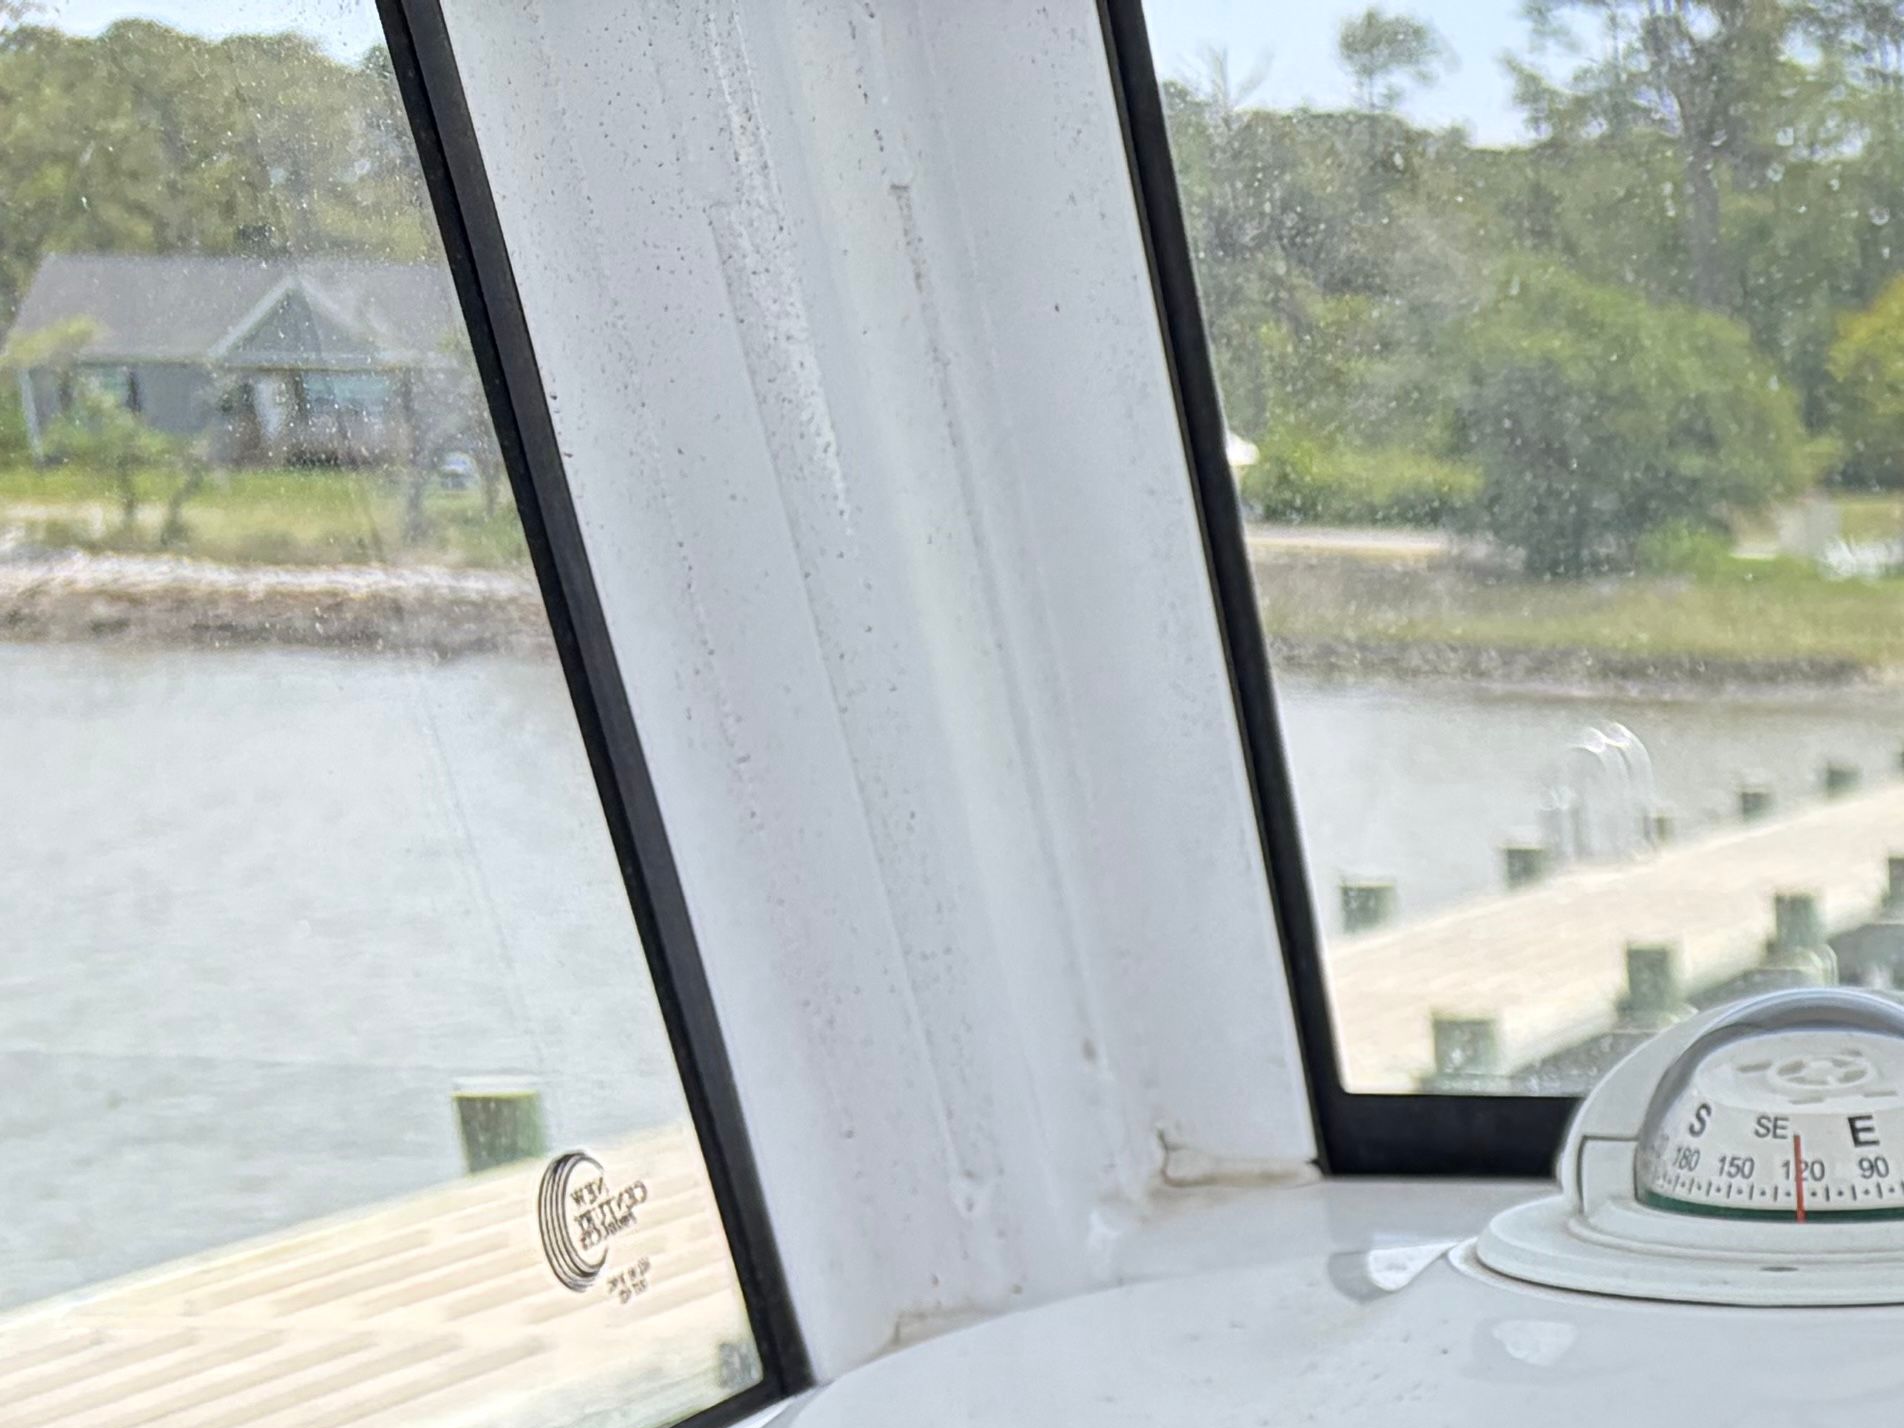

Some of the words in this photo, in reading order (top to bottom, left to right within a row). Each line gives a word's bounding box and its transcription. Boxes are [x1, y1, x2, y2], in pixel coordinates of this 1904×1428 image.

[1689, 1102, 1712, 1138] S
[1754, 1115, 1789, 1140] SE
[1847, 1114, 1880, 1147] E
[1672, 1145, 1700, 1172] 180
[1717, 1156, 1756, 1180] 150
[1781, 1159, 1827, 1182] 120
[1857, 1156, 1890, 1179] 90
